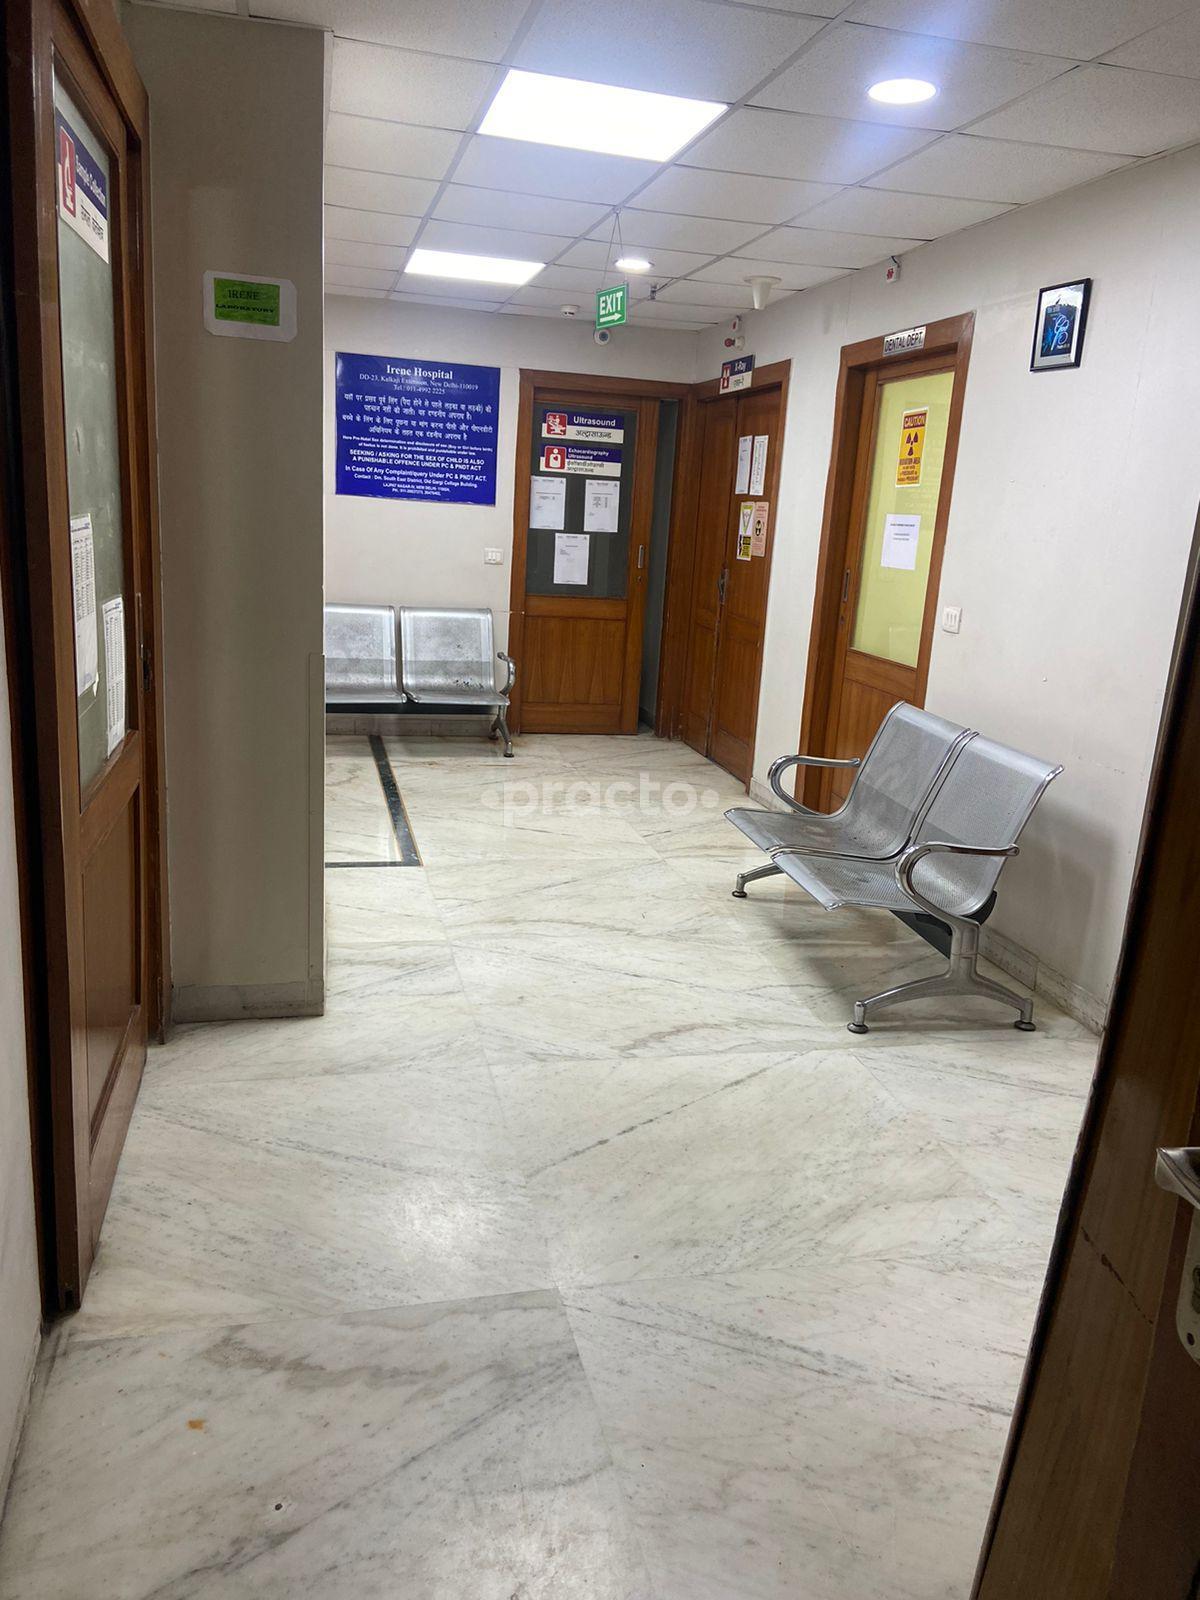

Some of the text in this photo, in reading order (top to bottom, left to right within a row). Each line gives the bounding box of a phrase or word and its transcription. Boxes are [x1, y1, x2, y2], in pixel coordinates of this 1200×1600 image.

[228, 289, 260, 300] IRENE
[216, 303, 274, 313] LABORATORY
[600, 291, 623, 315] EXIT
[884, 336, 906, 352] DENTAL
[386, 364, 452, 380] Irene Hospital
[573, 416, 616, 426] Ultrasound
[905, 415, 926, 427] CAUTION
[569, 448, 609, 456] Echocardiography
[358, 456, 393, 464] PUNISHABLE
